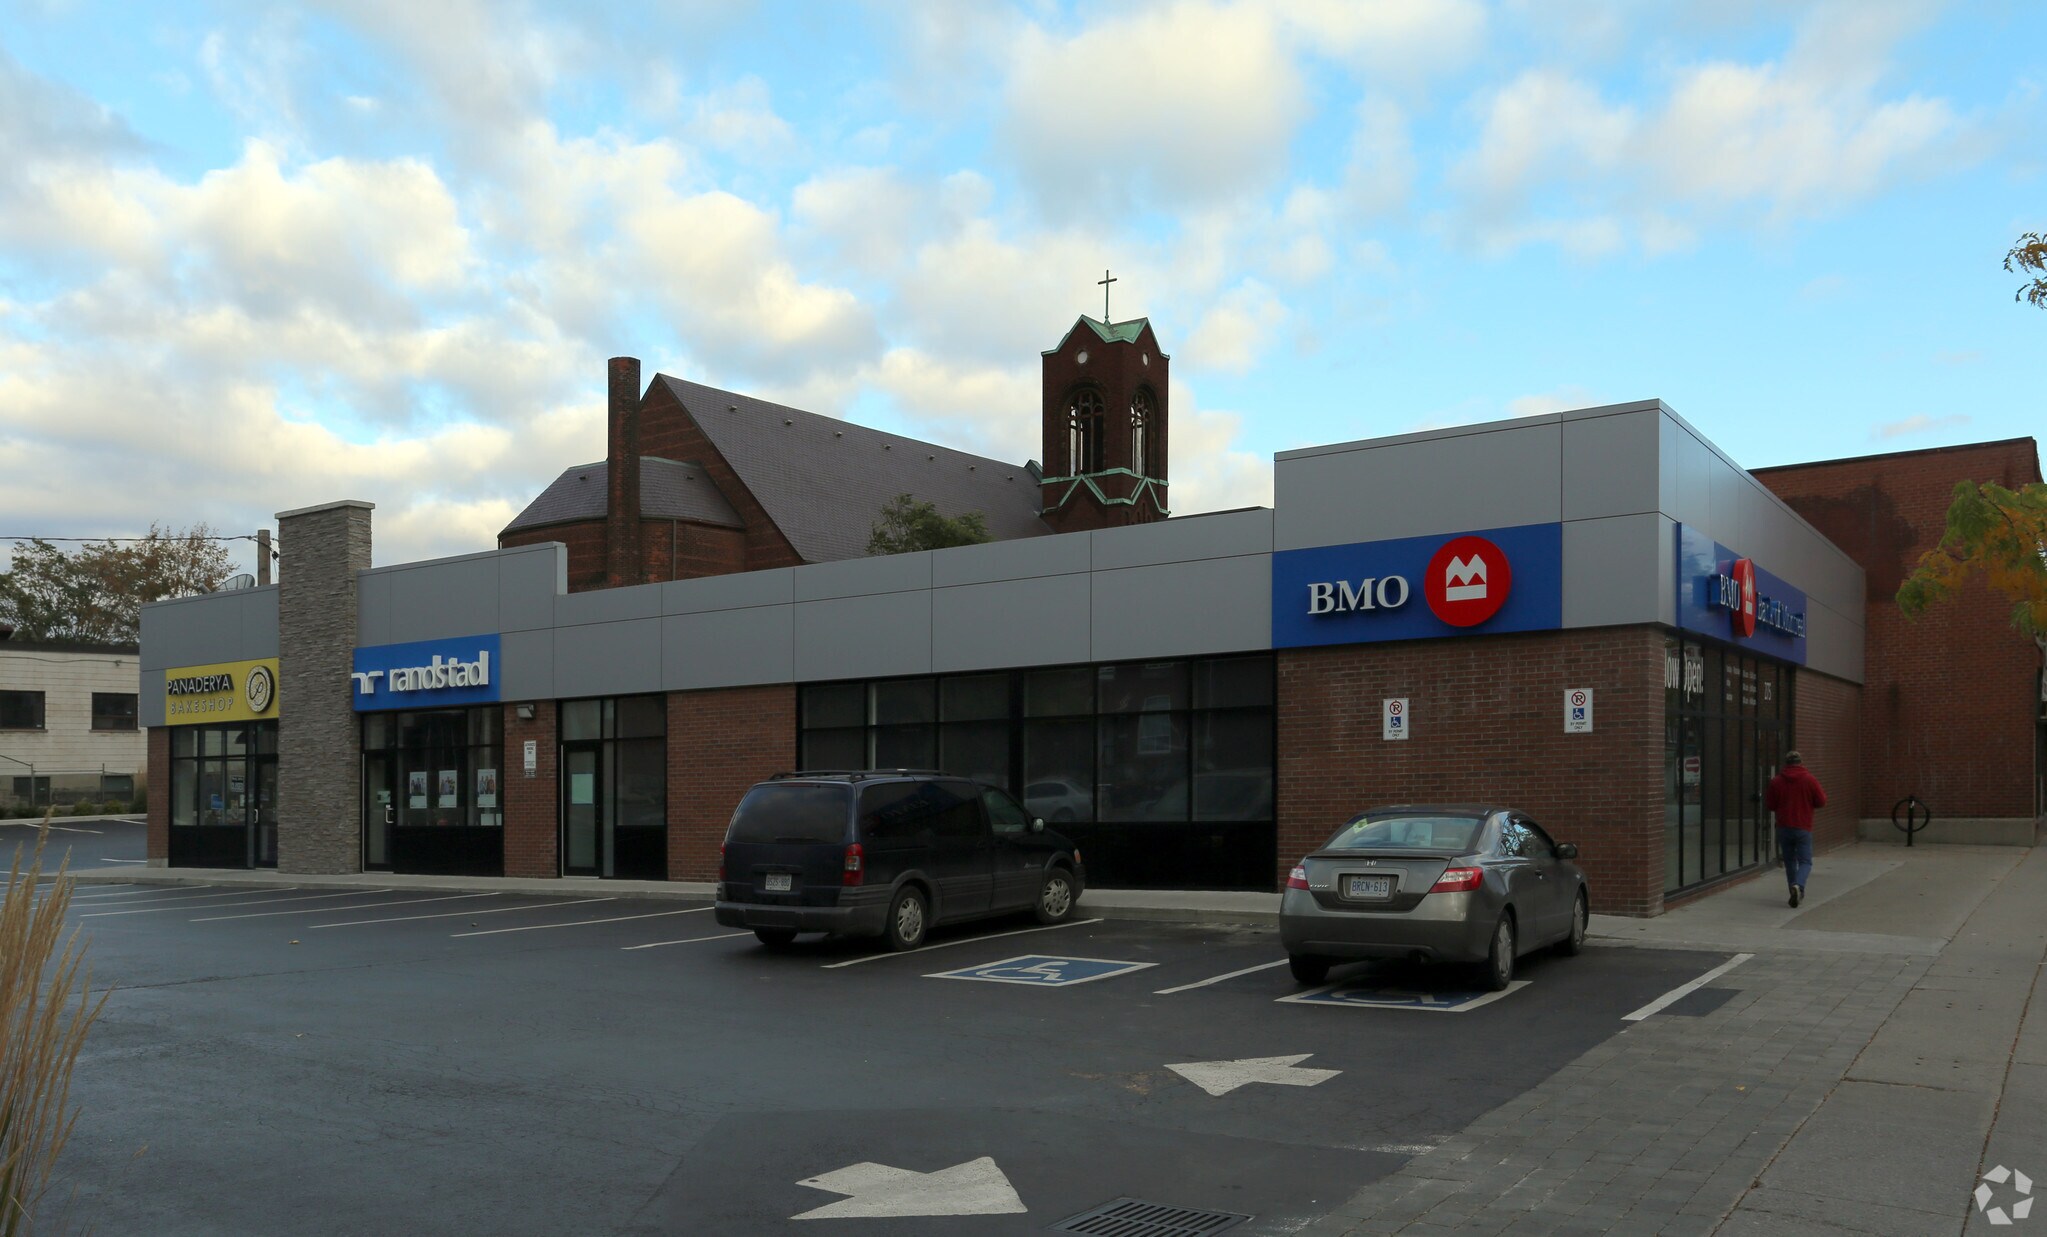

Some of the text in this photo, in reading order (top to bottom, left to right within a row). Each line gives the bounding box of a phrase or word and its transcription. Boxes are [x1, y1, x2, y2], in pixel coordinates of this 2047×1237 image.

[1307, 574, 1409, 615] BMO
[1720, 573, 1740, 612] BMO
[167, 674, 233, 695] PANADERYA
[389, 650, 489, 692] randstad
[170, 697, 233, 714] BAKESHOP
